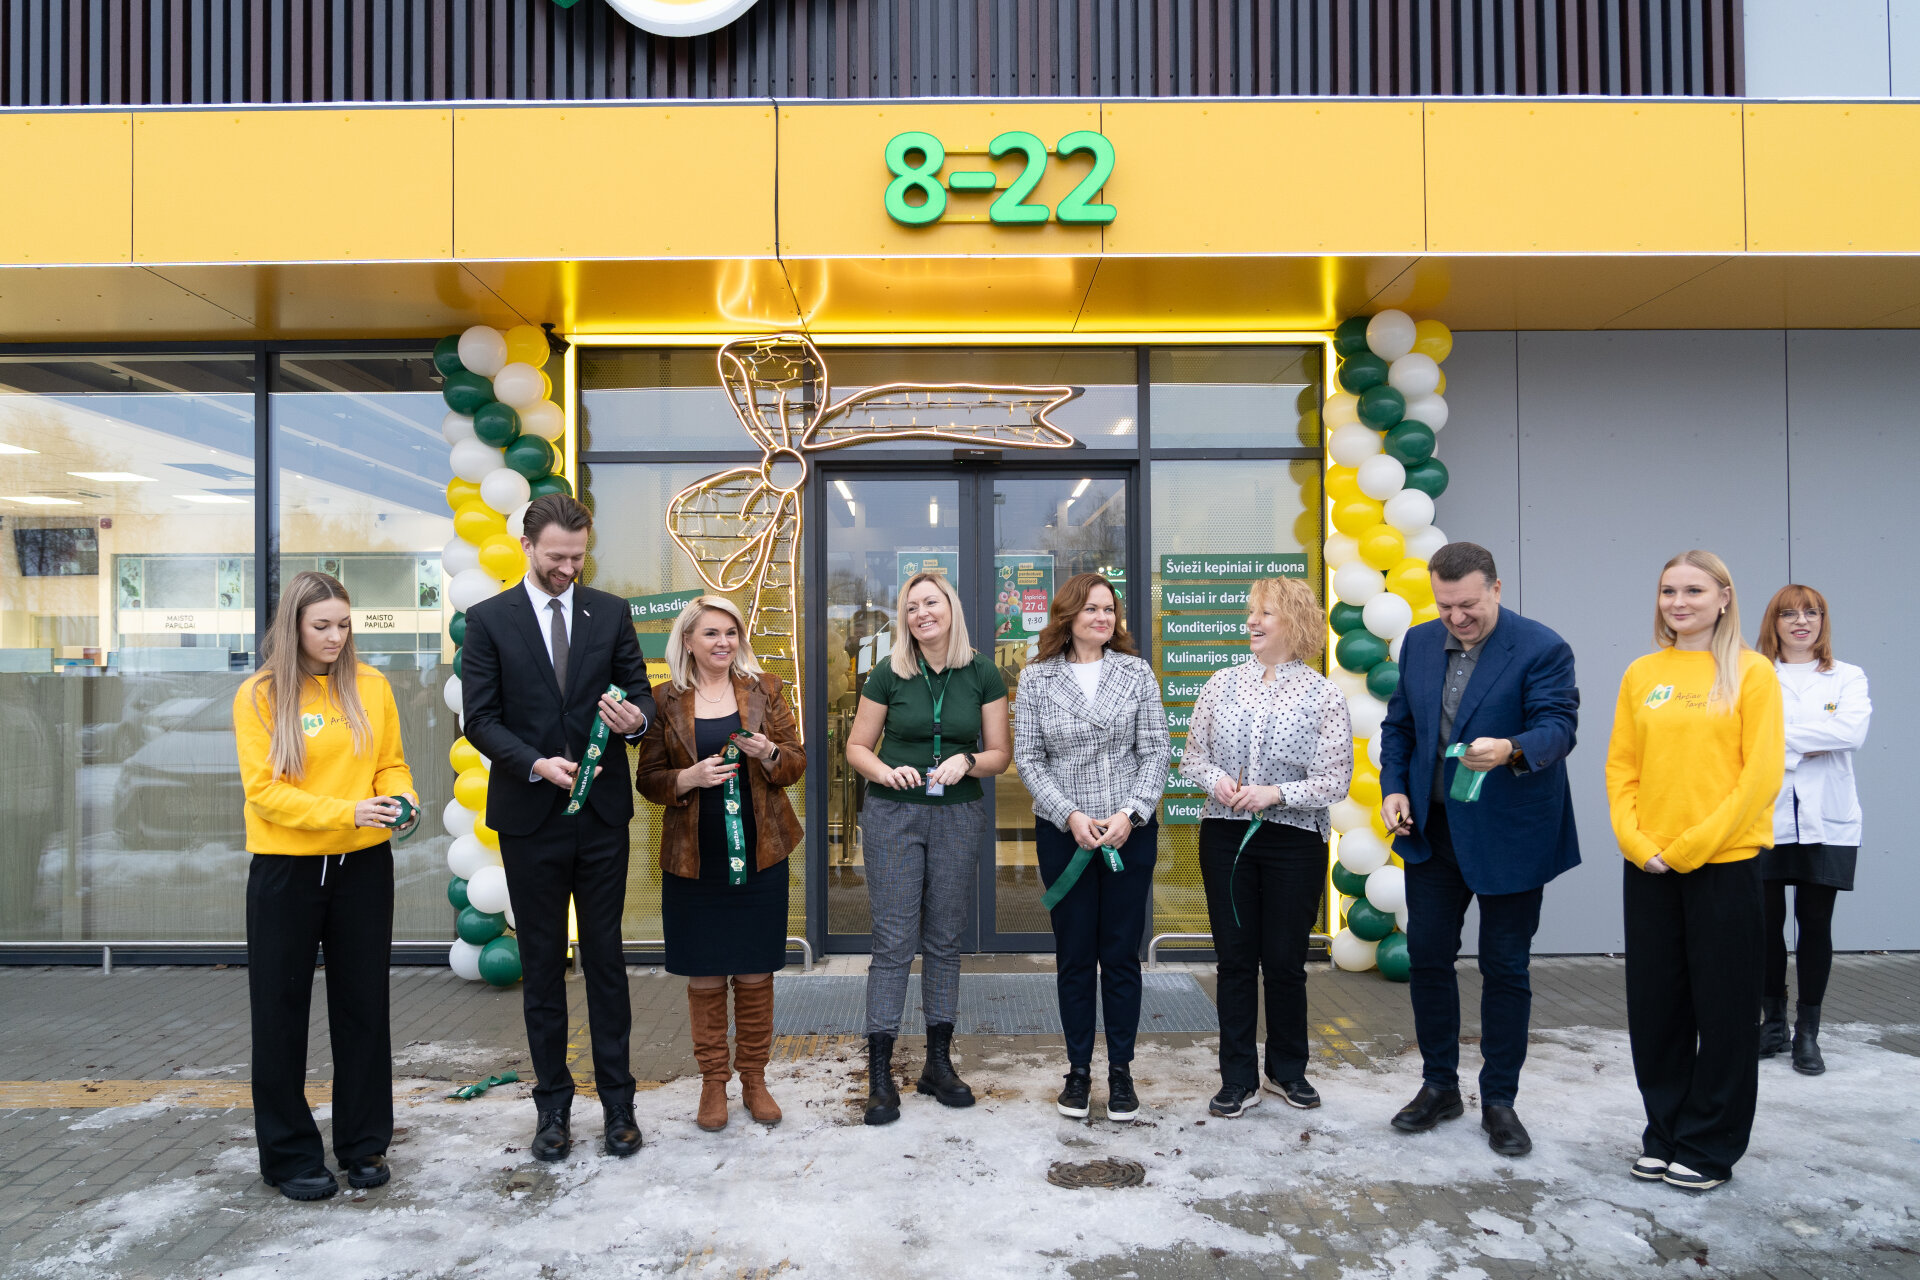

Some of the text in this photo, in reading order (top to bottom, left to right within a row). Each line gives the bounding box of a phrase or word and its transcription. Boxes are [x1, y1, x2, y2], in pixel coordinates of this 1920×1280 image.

[884, 130, 1117, 227] 8-22
[1166, 559, 1305, 575] Švieži kepiniai ir duona
[1166, 592, 1205, 604] Vaisiai
[1208, 592, 1217, 603] ir
[631, 598, 691, 616] ite kasdie
[1025, 602, 1046, 611] 27 d.
[1167, 621, 1237, 635] Konditerijos
[1167, 651, 1228, 665] Kulinarijos
[1645, 686, 1673, 705] iki
[302, 714, 324, 730] ki
[1168, 712, 1191, 726] Švie
